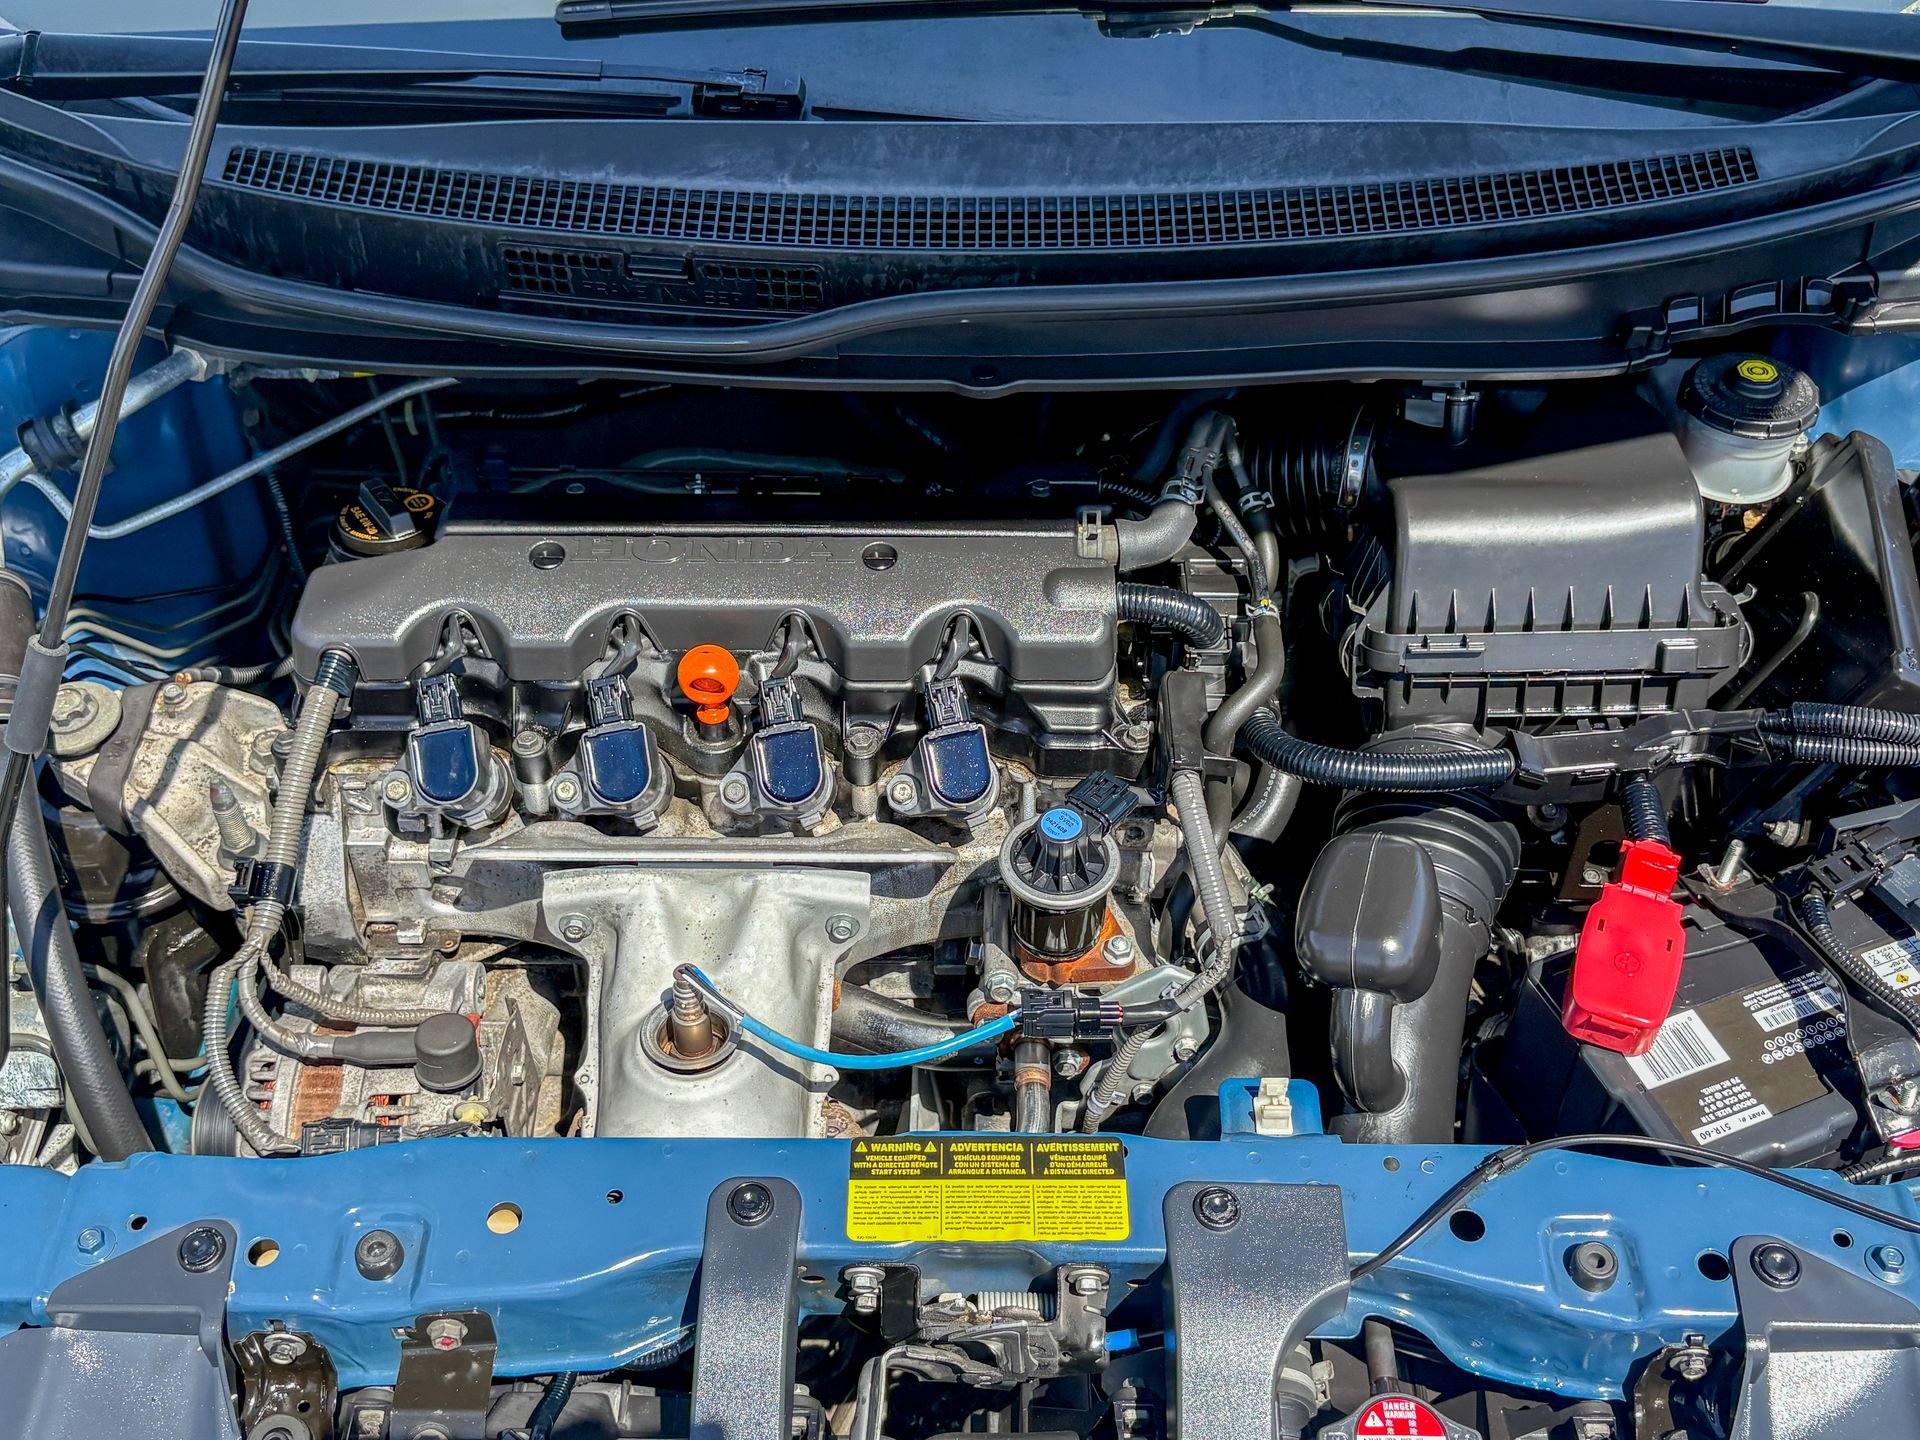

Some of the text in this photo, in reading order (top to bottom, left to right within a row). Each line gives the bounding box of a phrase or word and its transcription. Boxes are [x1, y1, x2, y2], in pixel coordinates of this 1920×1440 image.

[570, 537, 856, 564] HONDA
[1723, 1095, 1737, 1106] CCA
[1731, 1098, 1758, 1112] GROUP
[1714, 1106, 1731, 1118] SIZE:
[1748, 1110, 1766, 1120] PART
[1699, 1122, 1732, 1141] 51R-60
[870, 1142, 922, 1152] WARNING
[949, 1142, 1025, 1152] ADVERTENCIA
[1036, 1142, 1119, 1152] AVERTISSEMENT
[953, 1154, 986, 1162] VEHÍCULO
[1049, 1153, 1107, 1161] VÉHICULE ÉQUIPÉ
[1382, 1402, 1416, 1410] DANGER
[1383, 1410, 1417, 1419] WARNUNG
